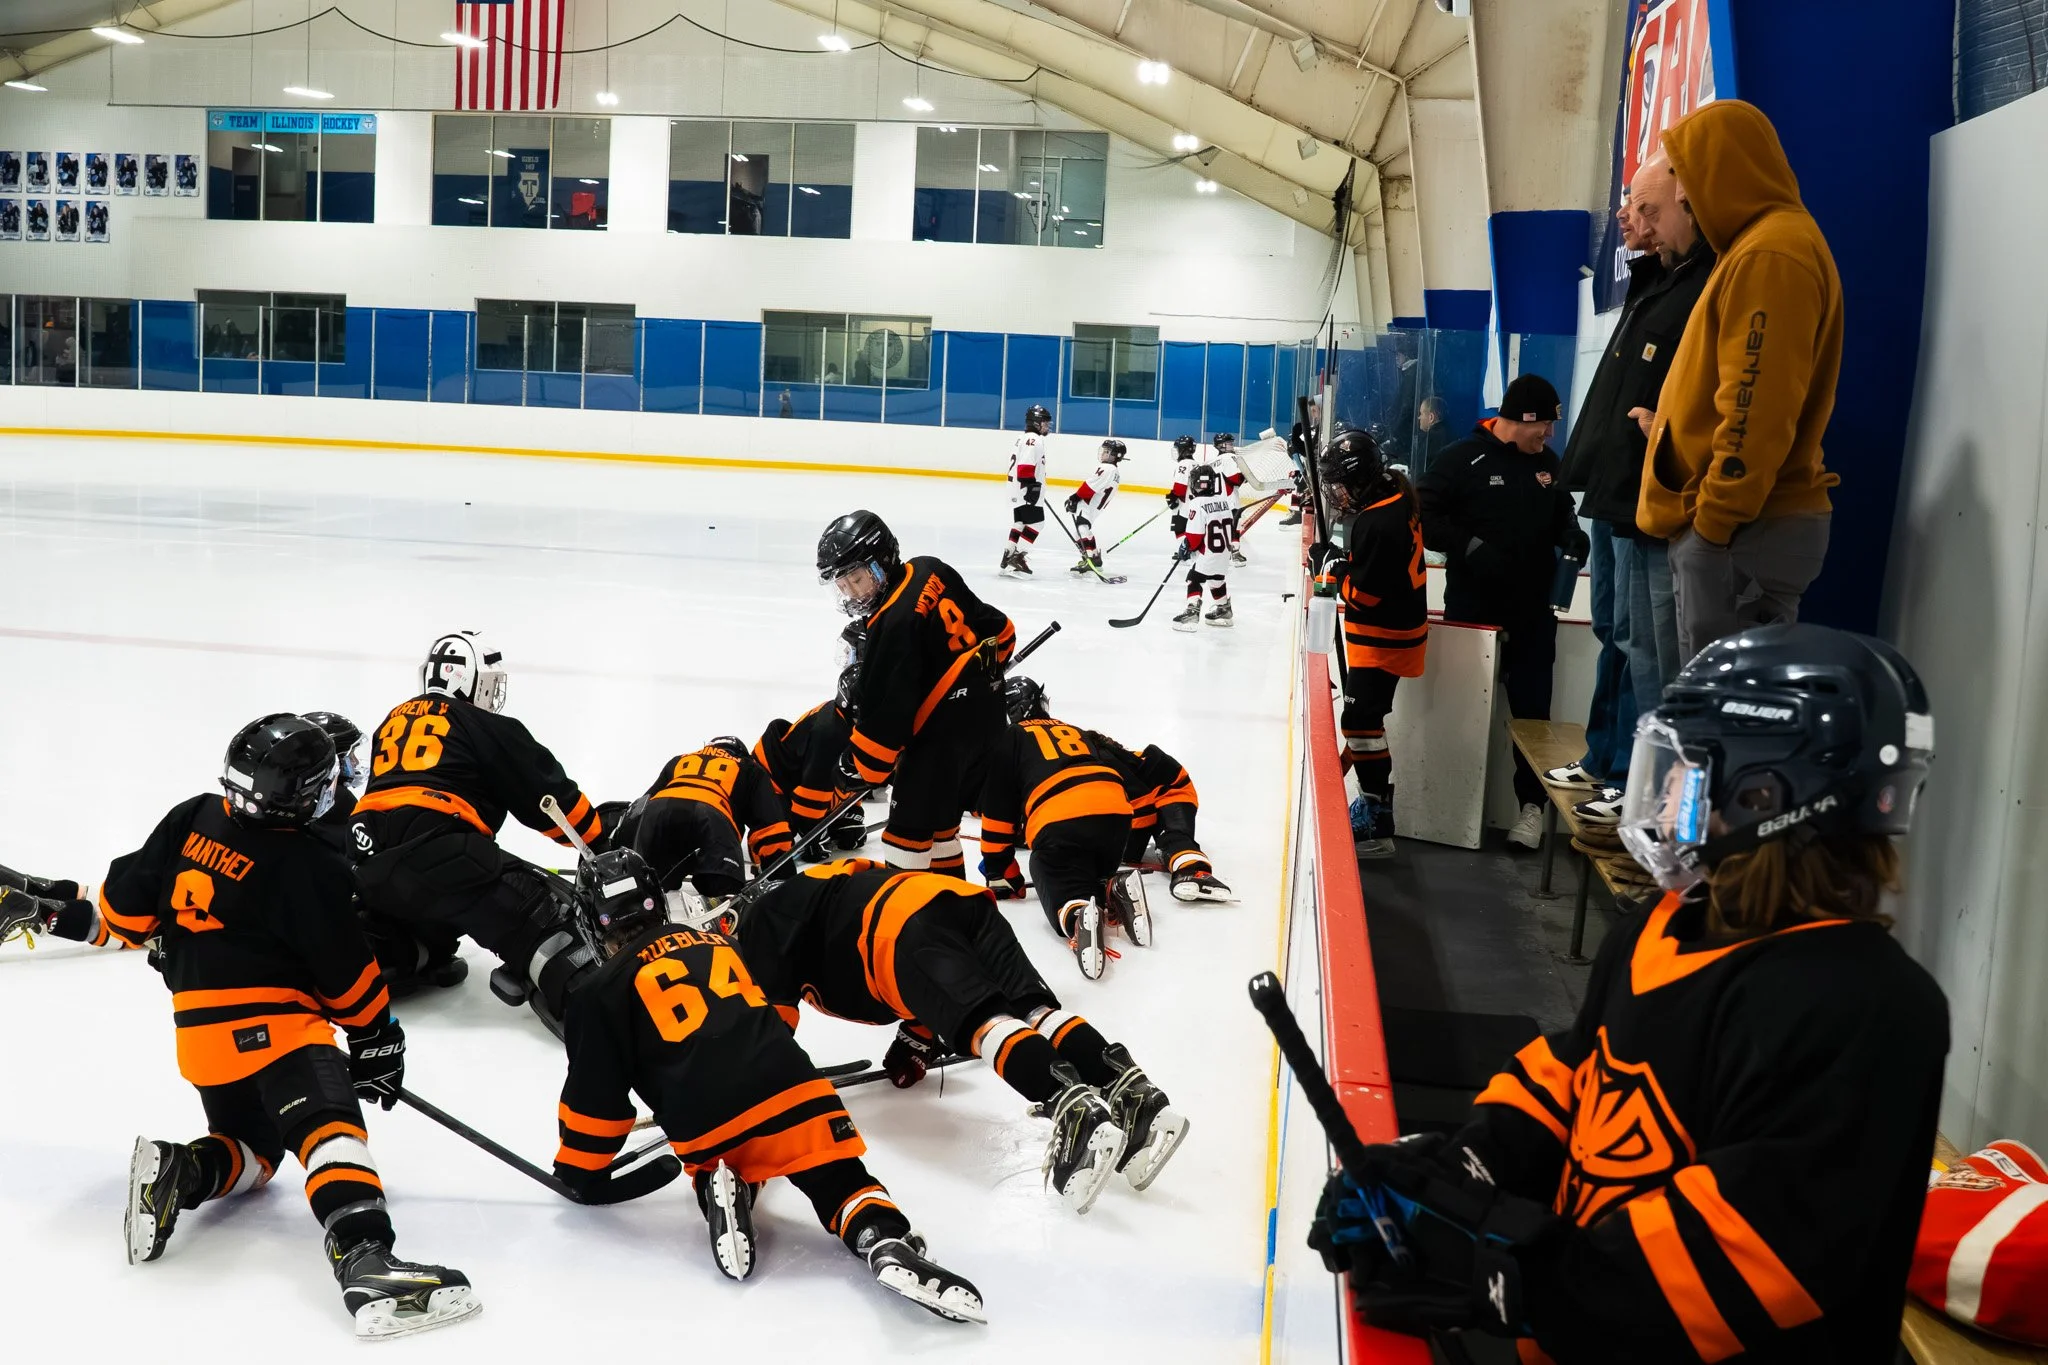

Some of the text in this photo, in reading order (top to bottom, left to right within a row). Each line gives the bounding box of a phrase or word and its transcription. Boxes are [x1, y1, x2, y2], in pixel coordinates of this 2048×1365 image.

[229, 115, 360, 130] TEAM ILLINOIS HOCKEY
[1727, 310, 1766, 452] carhartt
[1025, 438, 1036, 446] 42
[1207, 518, 1234, 554] 60
[938, 597, 978, 652] 8
[1720, 700, 1794, 721] BAUER
[373, 714, 451, 777] 36
[1023, 725, 1092, 761] 18
[634, 945, 769, 1043] 64
[278, 1096, 307, 1116] BAUER
